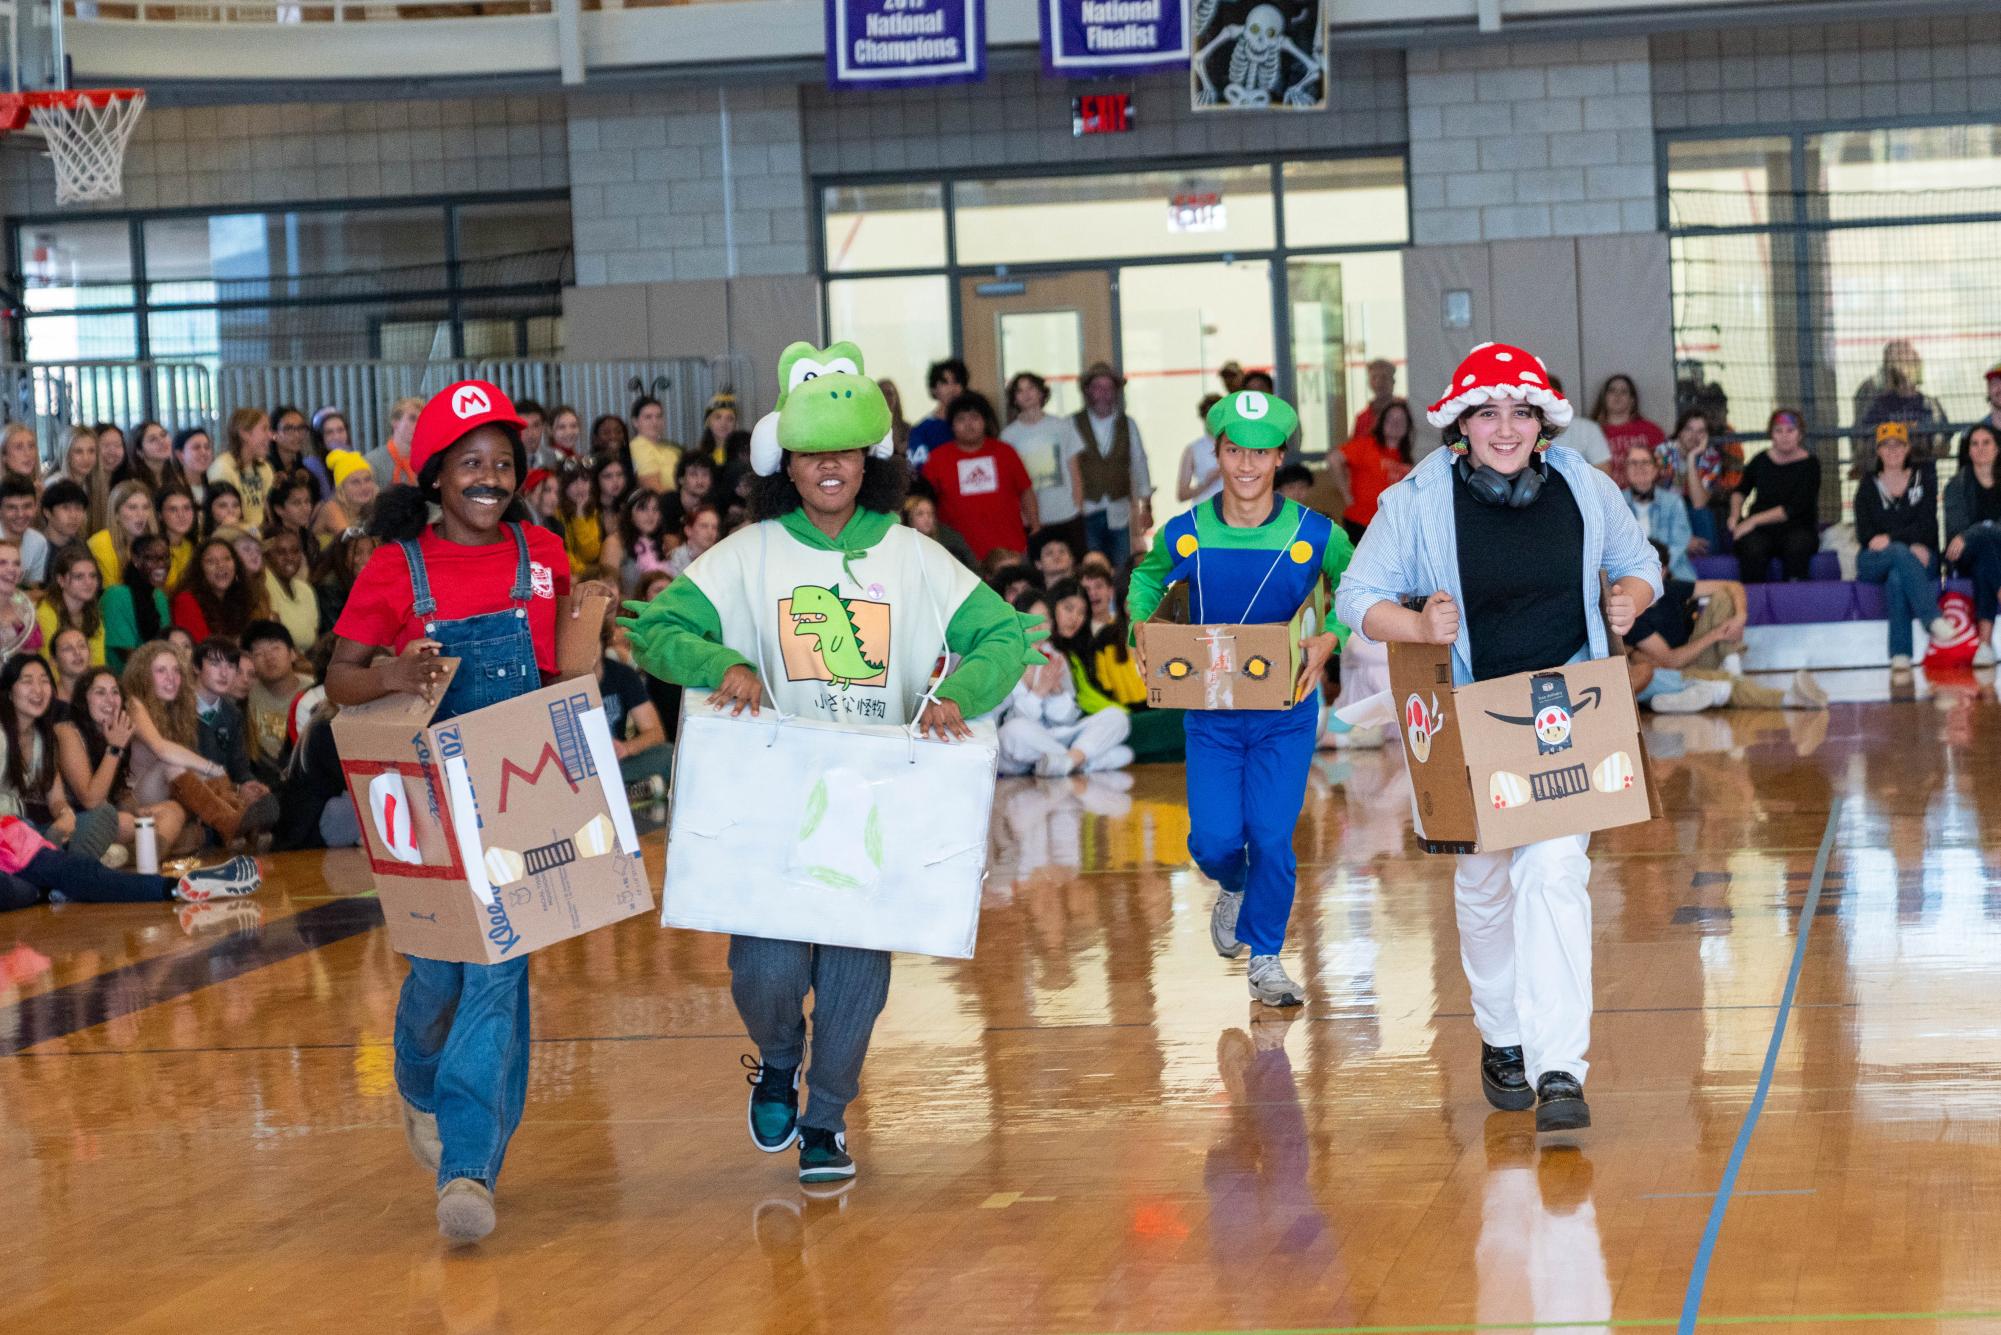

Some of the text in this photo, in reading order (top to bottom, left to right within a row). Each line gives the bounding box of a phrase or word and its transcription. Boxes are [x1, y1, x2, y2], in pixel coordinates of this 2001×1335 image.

[866, 9, 944, 37] National
[1081, 0, 1161, 24] National
[854, 37, 959, 63] Champions
[1086, 24, 1156, 50] Finalist
[460, 391, 487, 414] M
[1245, 395, 1259, 413] L
[814, 693, 887, 719] 小さな怪物
[438, 727, 463, 758] 02
[498, 740, 581, 814] M
